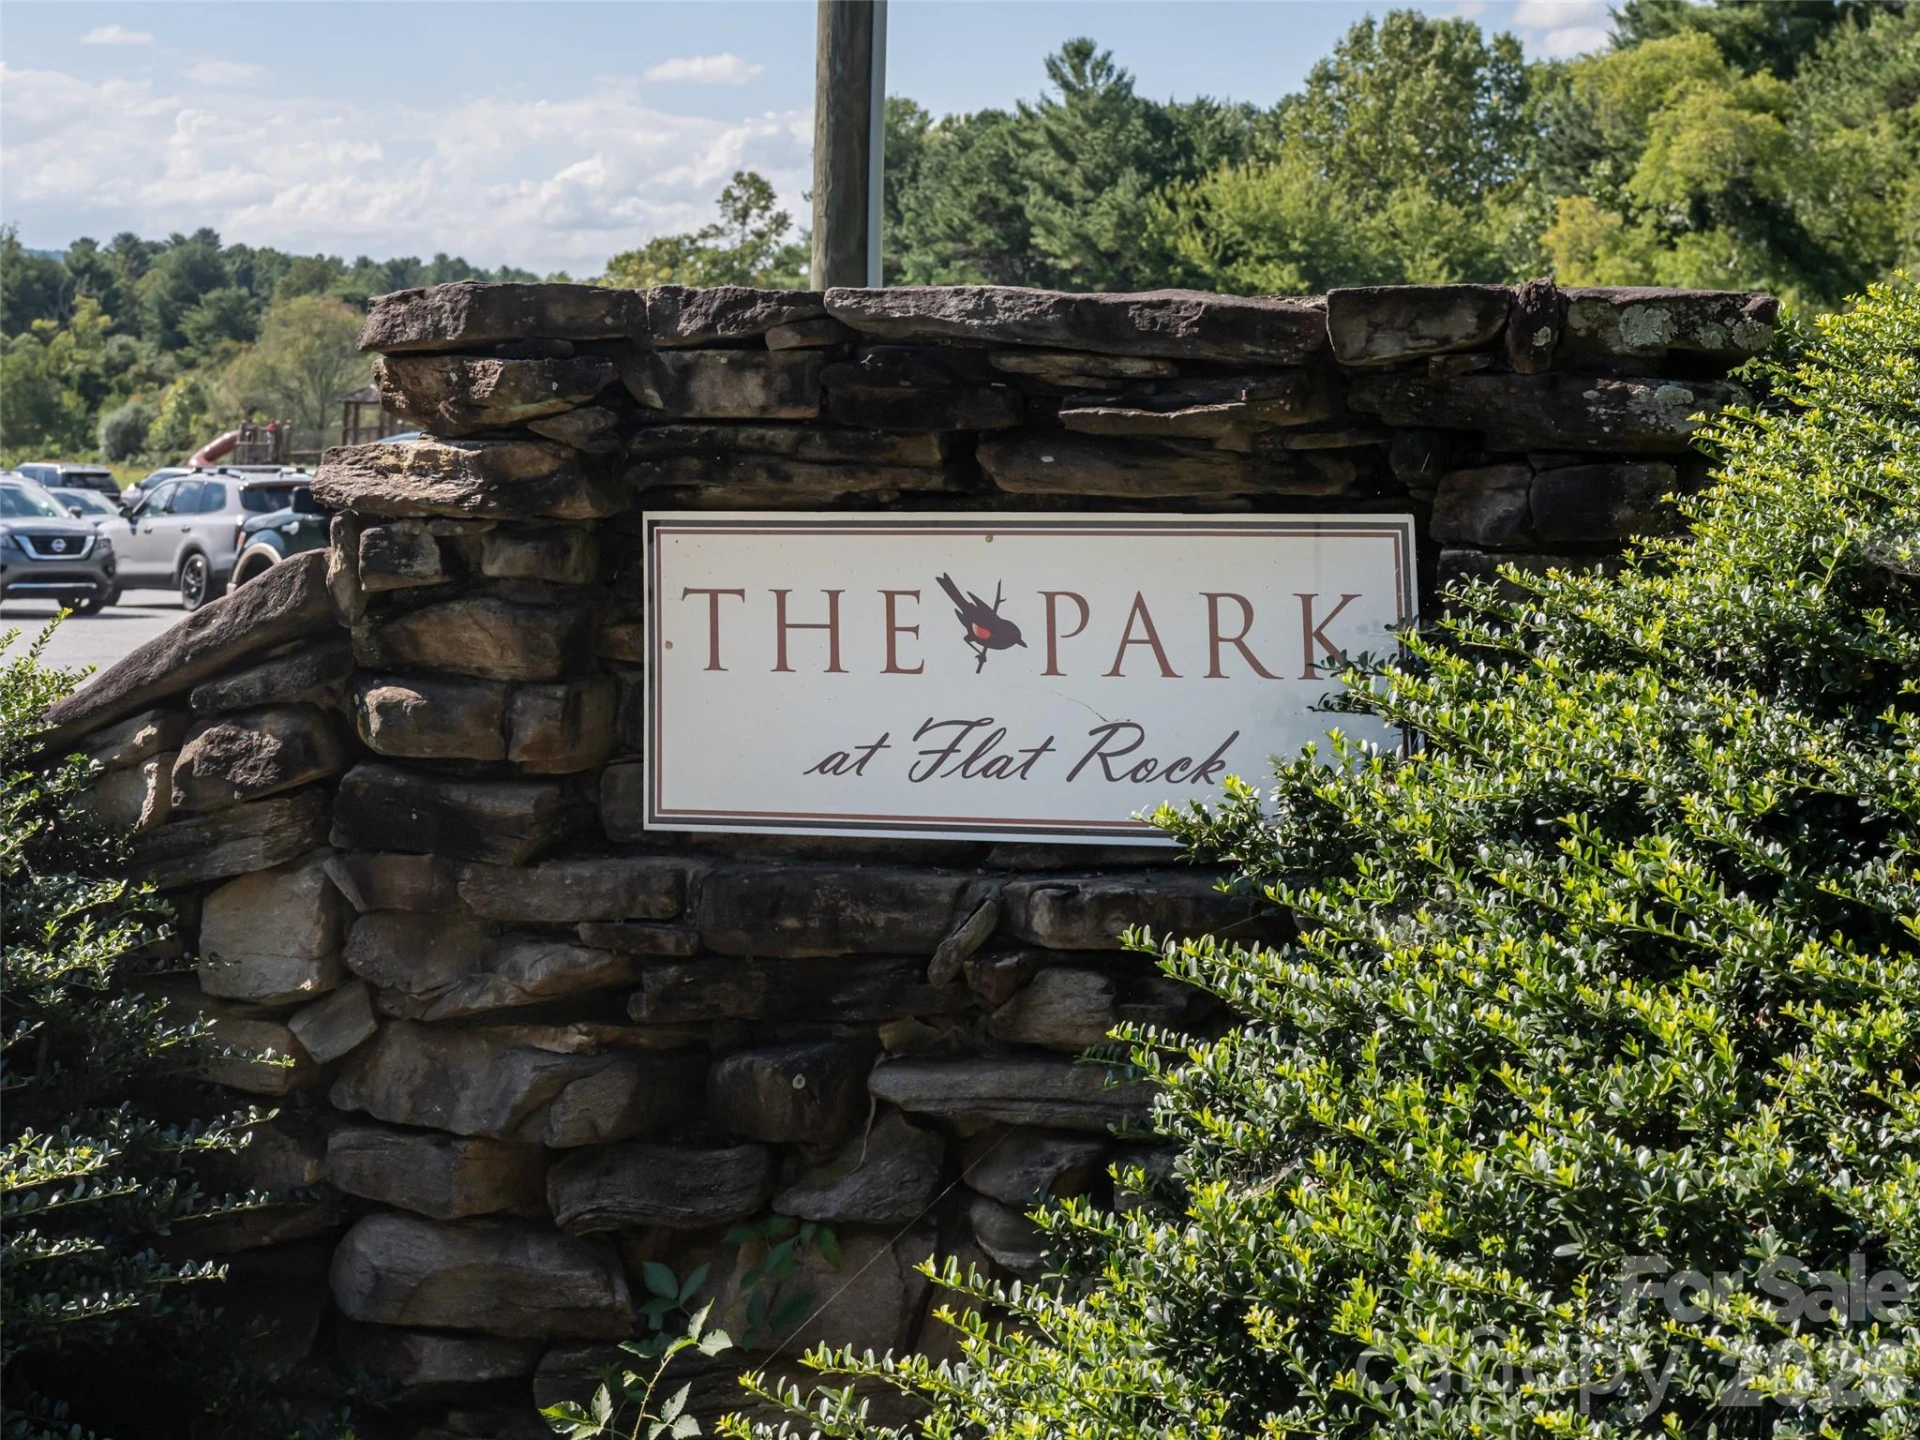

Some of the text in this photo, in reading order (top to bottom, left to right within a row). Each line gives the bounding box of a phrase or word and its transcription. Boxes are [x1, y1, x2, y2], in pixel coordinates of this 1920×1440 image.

[681, 587, 1371, 681] THE PARK
[803, 717, 1241, 785] at Flat Rock
